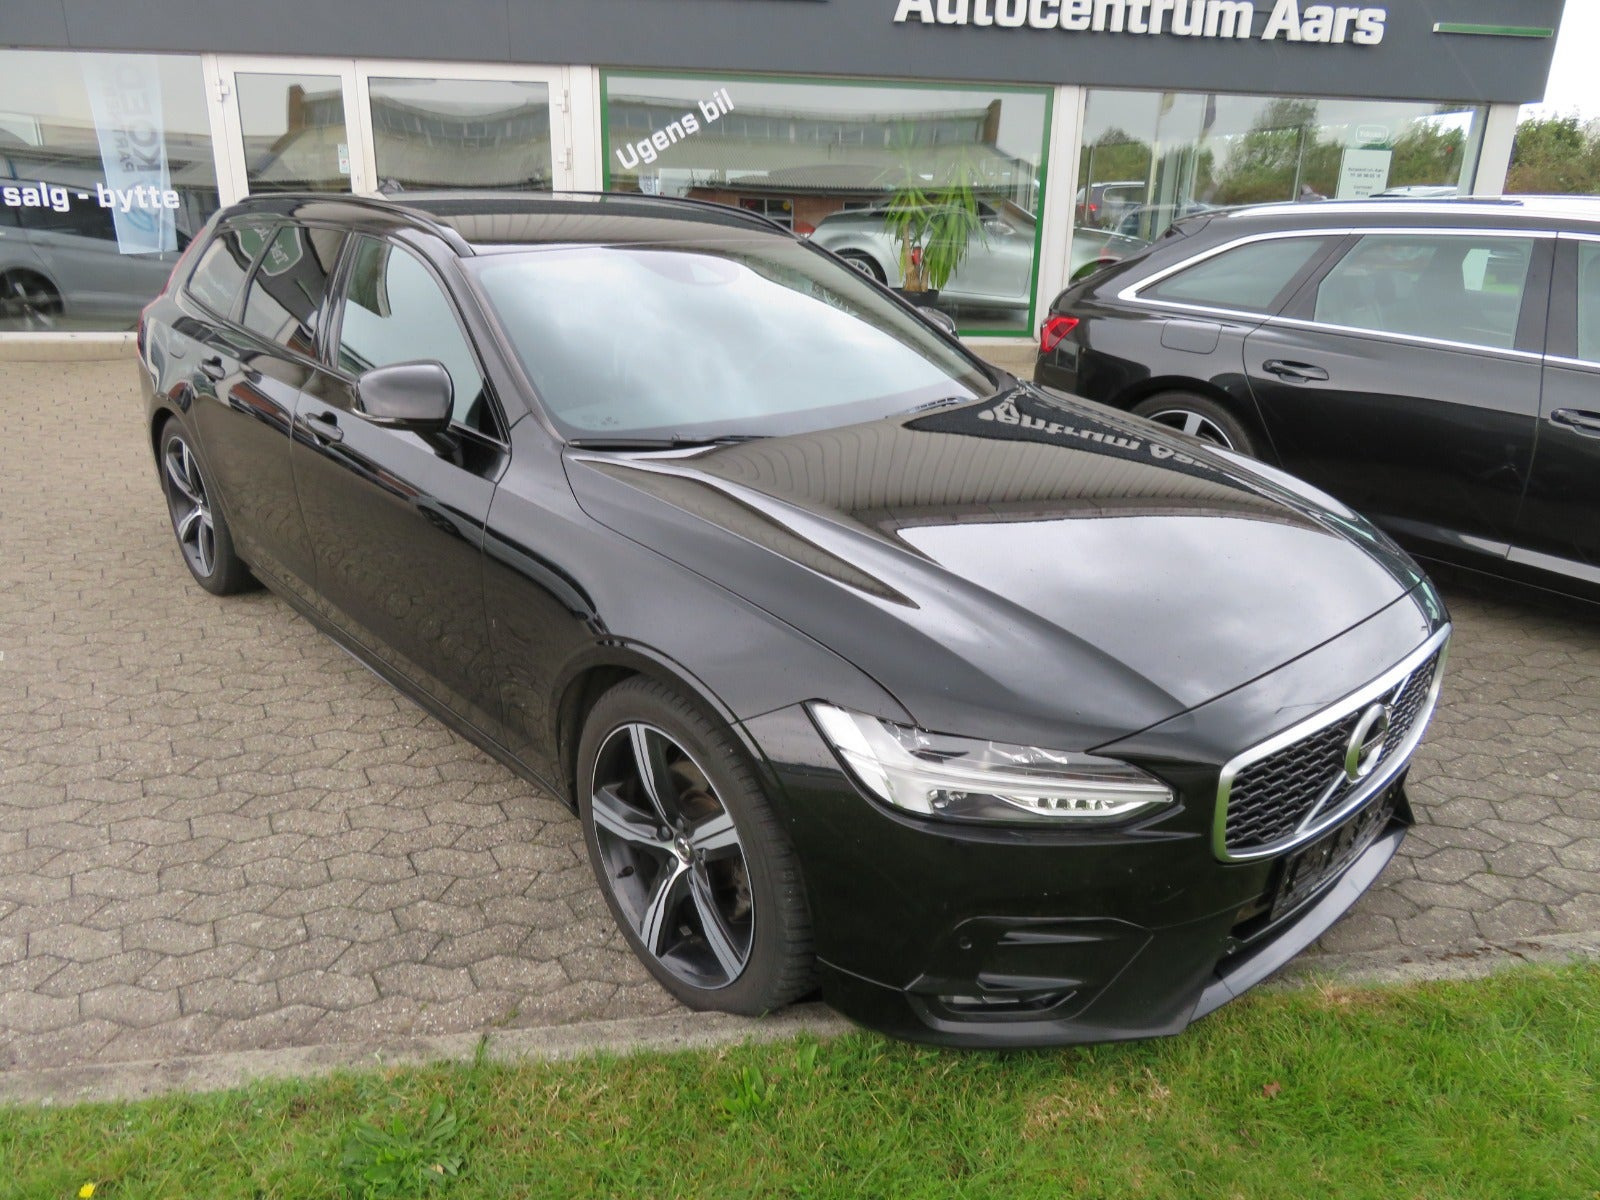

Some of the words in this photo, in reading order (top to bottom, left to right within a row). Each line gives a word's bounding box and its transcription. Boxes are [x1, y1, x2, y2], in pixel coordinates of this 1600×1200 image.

[1261, 0, 1387, 45] Aars
[616, 112, 700, 170] Ugens
[698, 87, 735, 123] bil
[3, 182, 70, 212] salg
[96, 182, 180, 213] bytte
